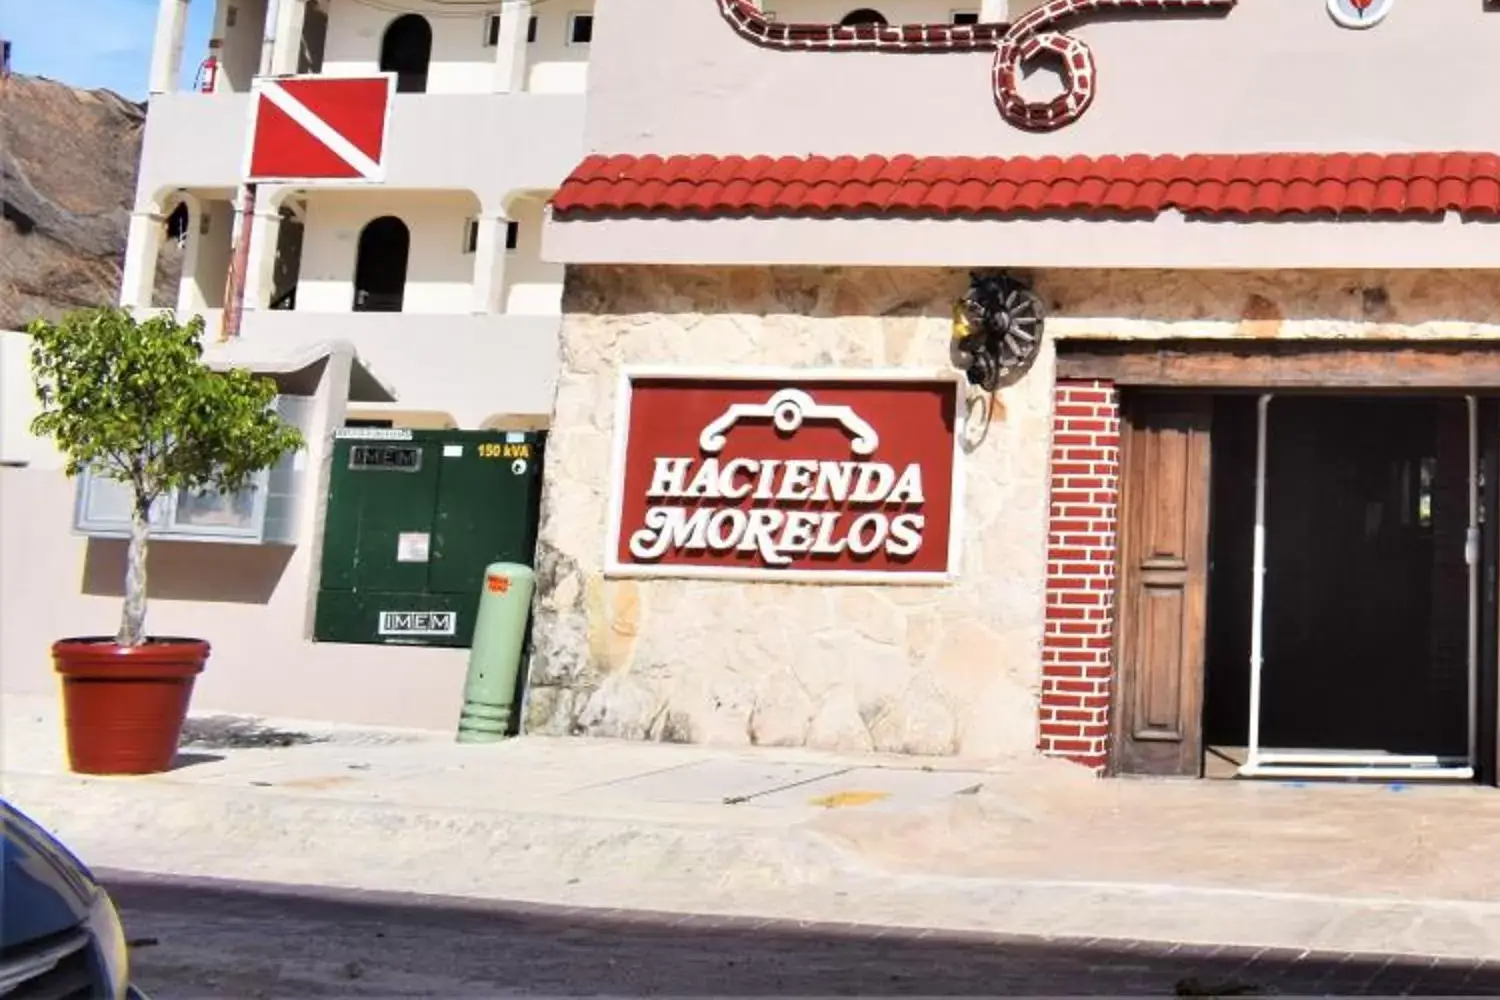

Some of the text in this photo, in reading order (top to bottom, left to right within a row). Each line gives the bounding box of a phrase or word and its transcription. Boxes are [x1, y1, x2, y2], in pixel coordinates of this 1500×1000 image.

[477, 443, 501, 457] 150
[645, 456, 925, 504] HACIENDA
[629, 505, 926, 565] MORELOS
[384, 613, 450, 630] IMEM
